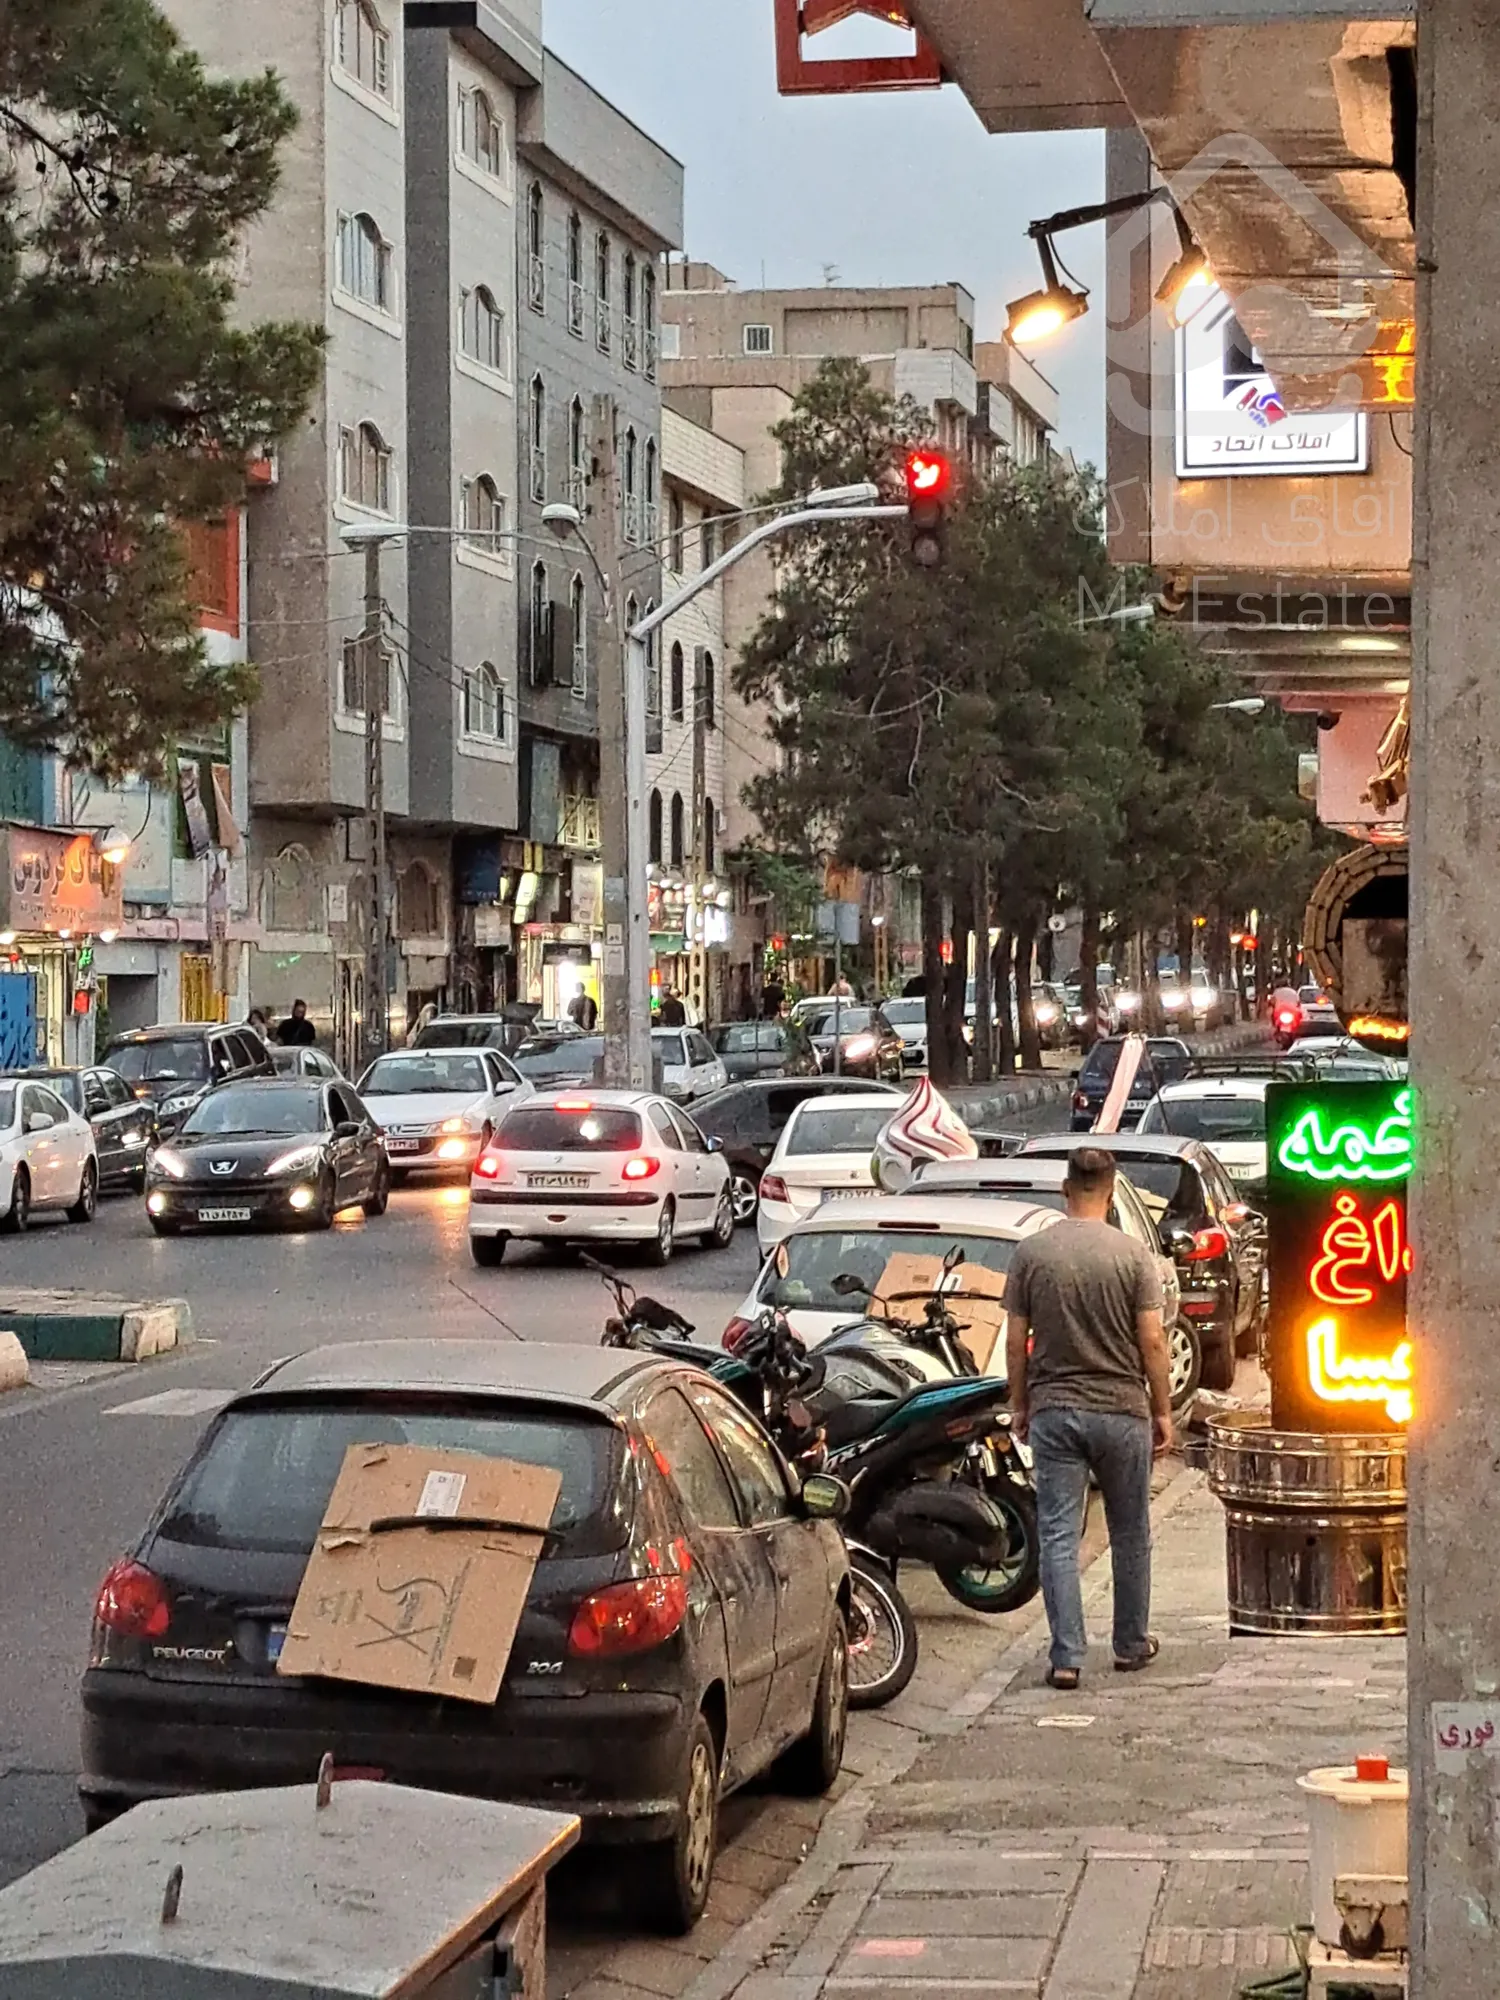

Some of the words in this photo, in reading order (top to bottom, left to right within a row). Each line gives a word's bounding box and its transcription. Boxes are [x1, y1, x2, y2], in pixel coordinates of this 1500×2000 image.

[1212, 434, 1263, 452] اتحاد
[1271, 432, 1331, 450] املاک
[1310, 1195, 1412, 1303] اغ
[153, 1645, 227, 1661] PEUGEOT
[526, 1660, 563, 1674] 206
[1440, 1720, 1494, 1749] فوری
